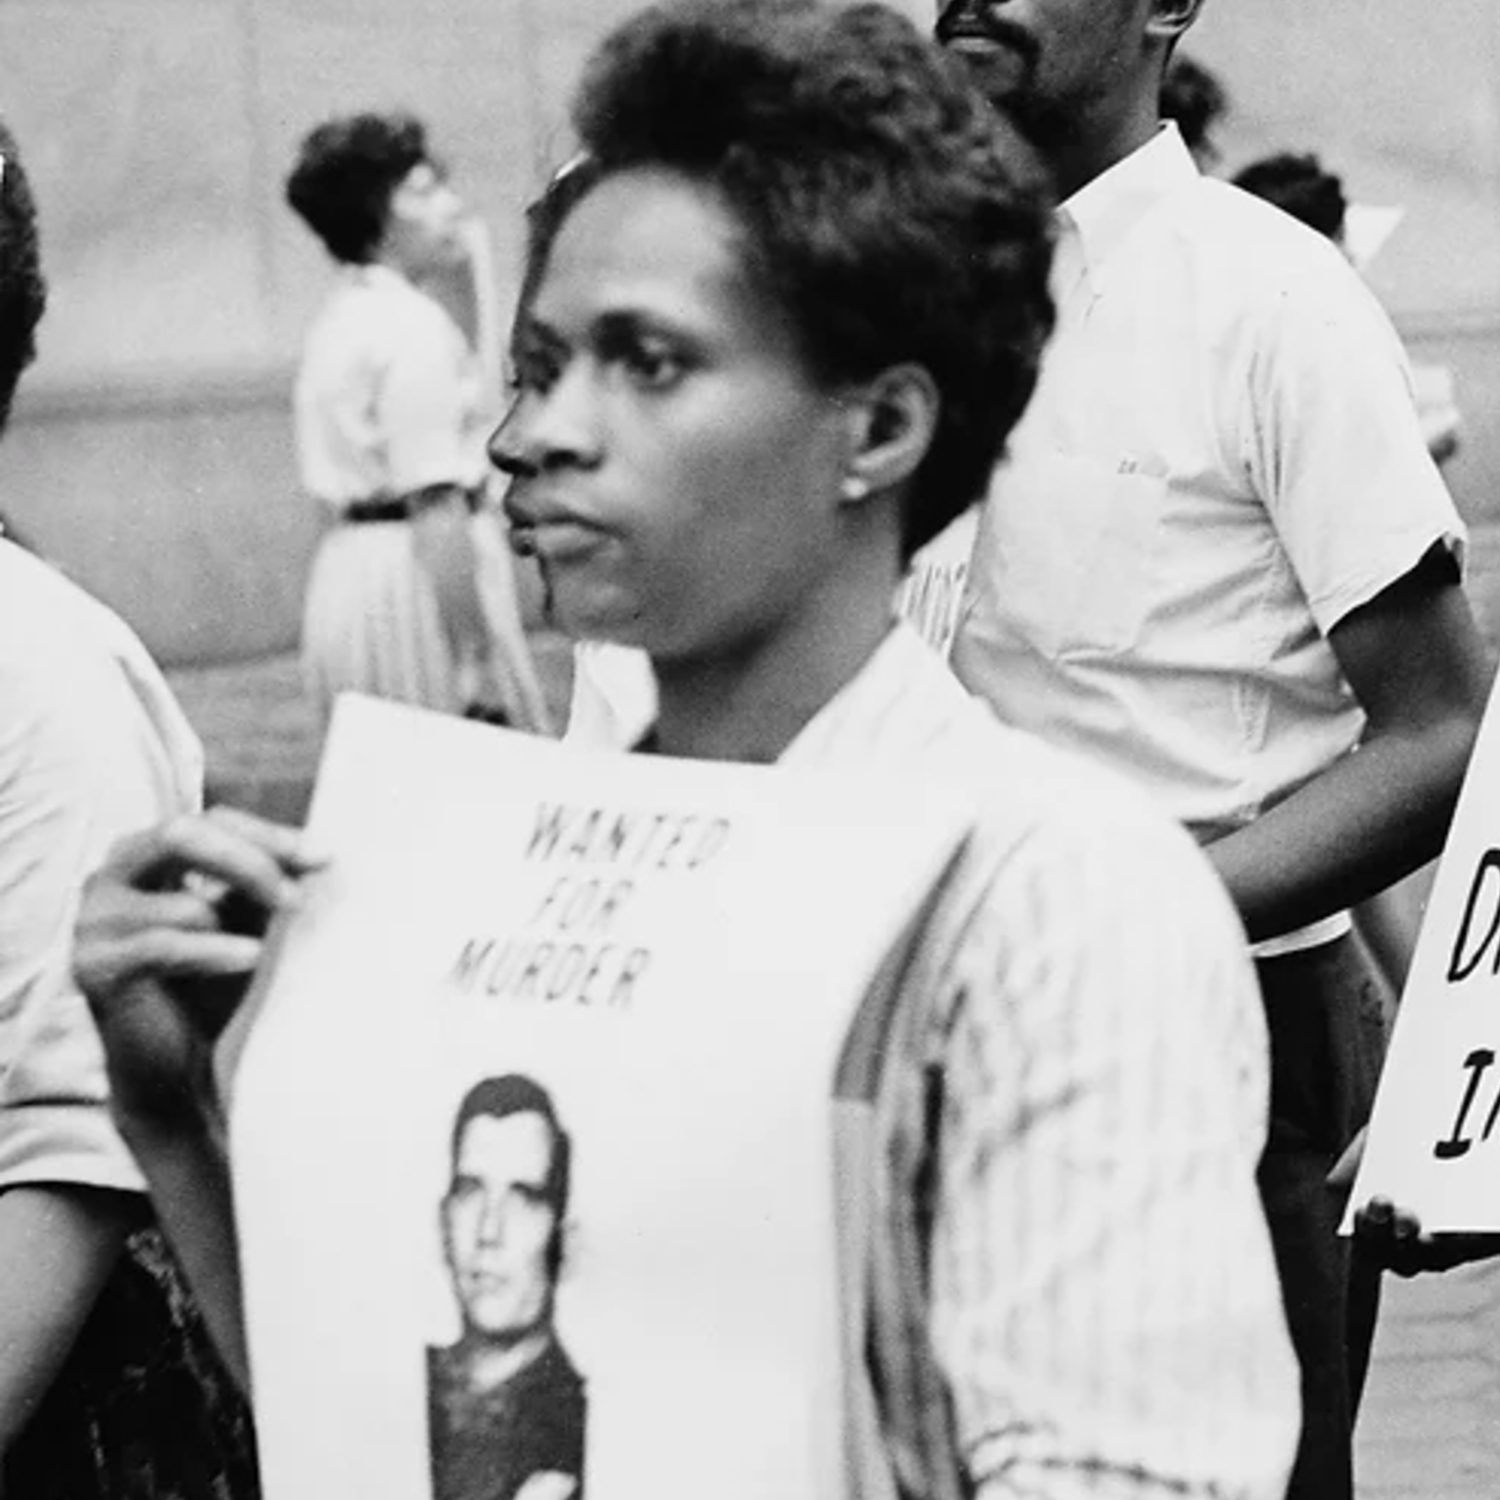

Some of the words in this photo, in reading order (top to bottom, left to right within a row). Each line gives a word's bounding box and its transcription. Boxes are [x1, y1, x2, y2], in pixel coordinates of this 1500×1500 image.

[524, 800, 731, 869] WANTED
[526, 875, 634, 932] FOR
[447, 937, 652, 1010] MURDER
